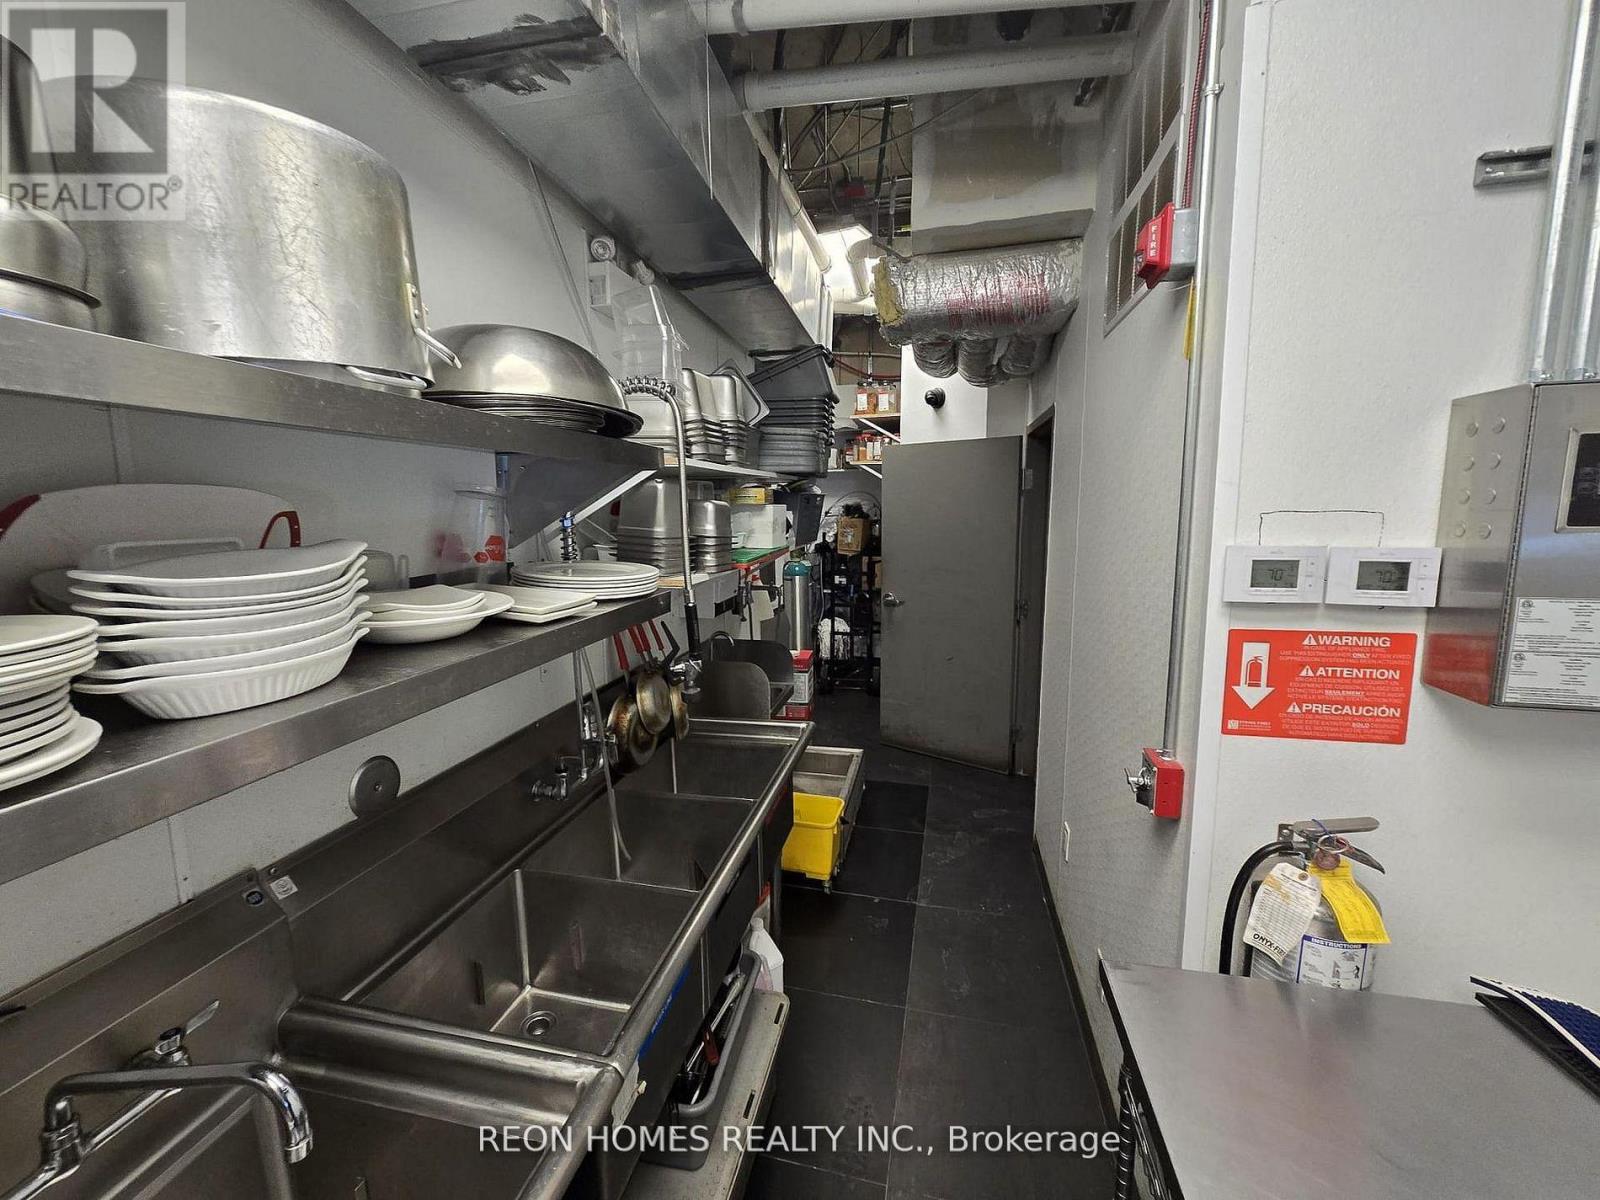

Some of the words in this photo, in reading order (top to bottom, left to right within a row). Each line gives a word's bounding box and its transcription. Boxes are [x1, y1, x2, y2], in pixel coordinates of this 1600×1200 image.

[1150, 225, 1158, 257] FIRE
[1318, 635, 1391, 647] WARNING
[1315, 667, 1400, 680] ATTENTION
[1302, 703, 1401, 717] PRECAUCIÓN
